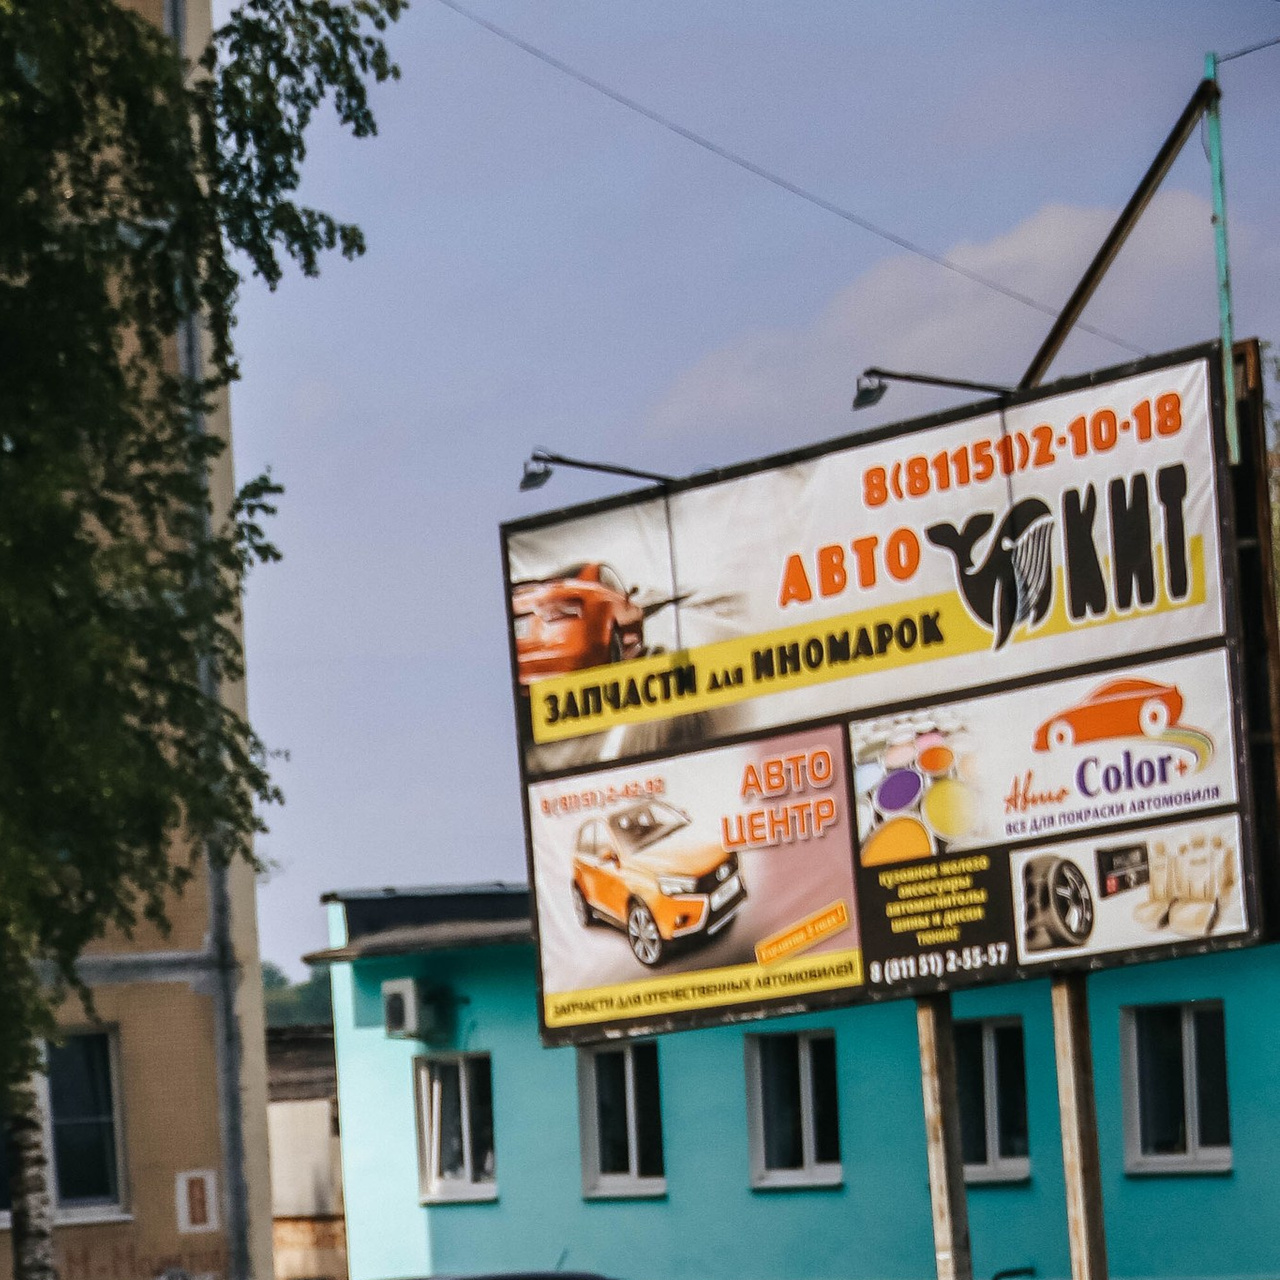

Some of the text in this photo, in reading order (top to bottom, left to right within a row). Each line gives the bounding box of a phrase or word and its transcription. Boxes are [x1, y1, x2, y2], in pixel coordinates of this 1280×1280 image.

[778, 462, 1191, 621] АВТО КИТ
[543, 664, 697, 724] ЗАПЧАСТИ
[751, 610, 944, 679] ИНОМАРОК
[740, 749, 833, 799] АВТО
[722, 797, 838, 851] ЦЕНТР
[1030, 813, 1055, 832] ДЛЯ
[1130, 785, 1221, 814] АВТОМОБИЛЯ
